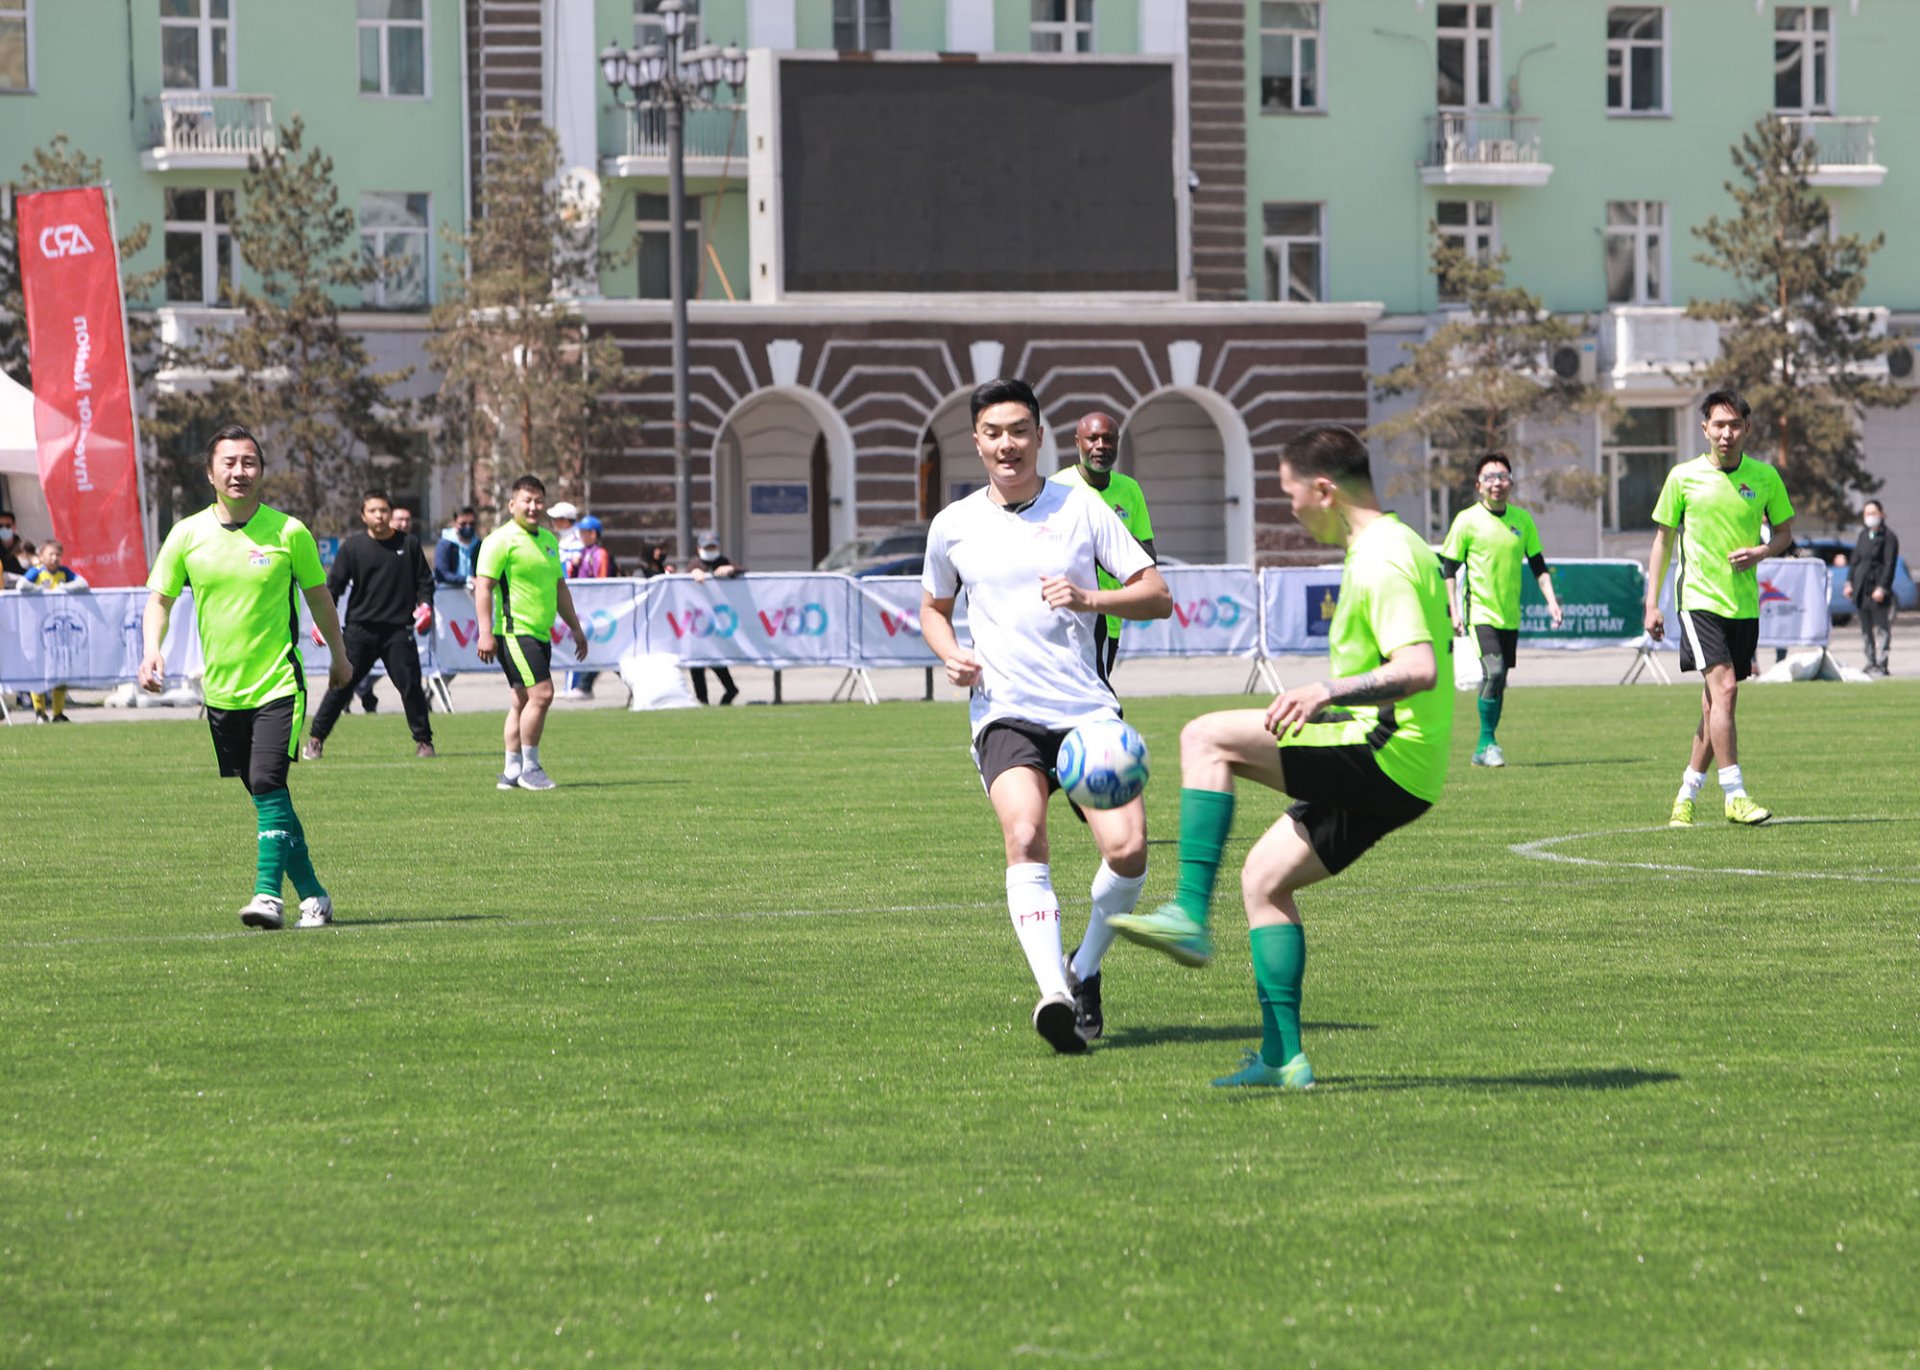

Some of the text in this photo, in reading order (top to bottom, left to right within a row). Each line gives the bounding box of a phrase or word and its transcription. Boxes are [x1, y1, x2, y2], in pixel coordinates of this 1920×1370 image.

[1525, 604, 1610, 617] GRASROOTS
[1550, 618, 1575, 632] AY
[1599, 617, 1625, 632] MAY
